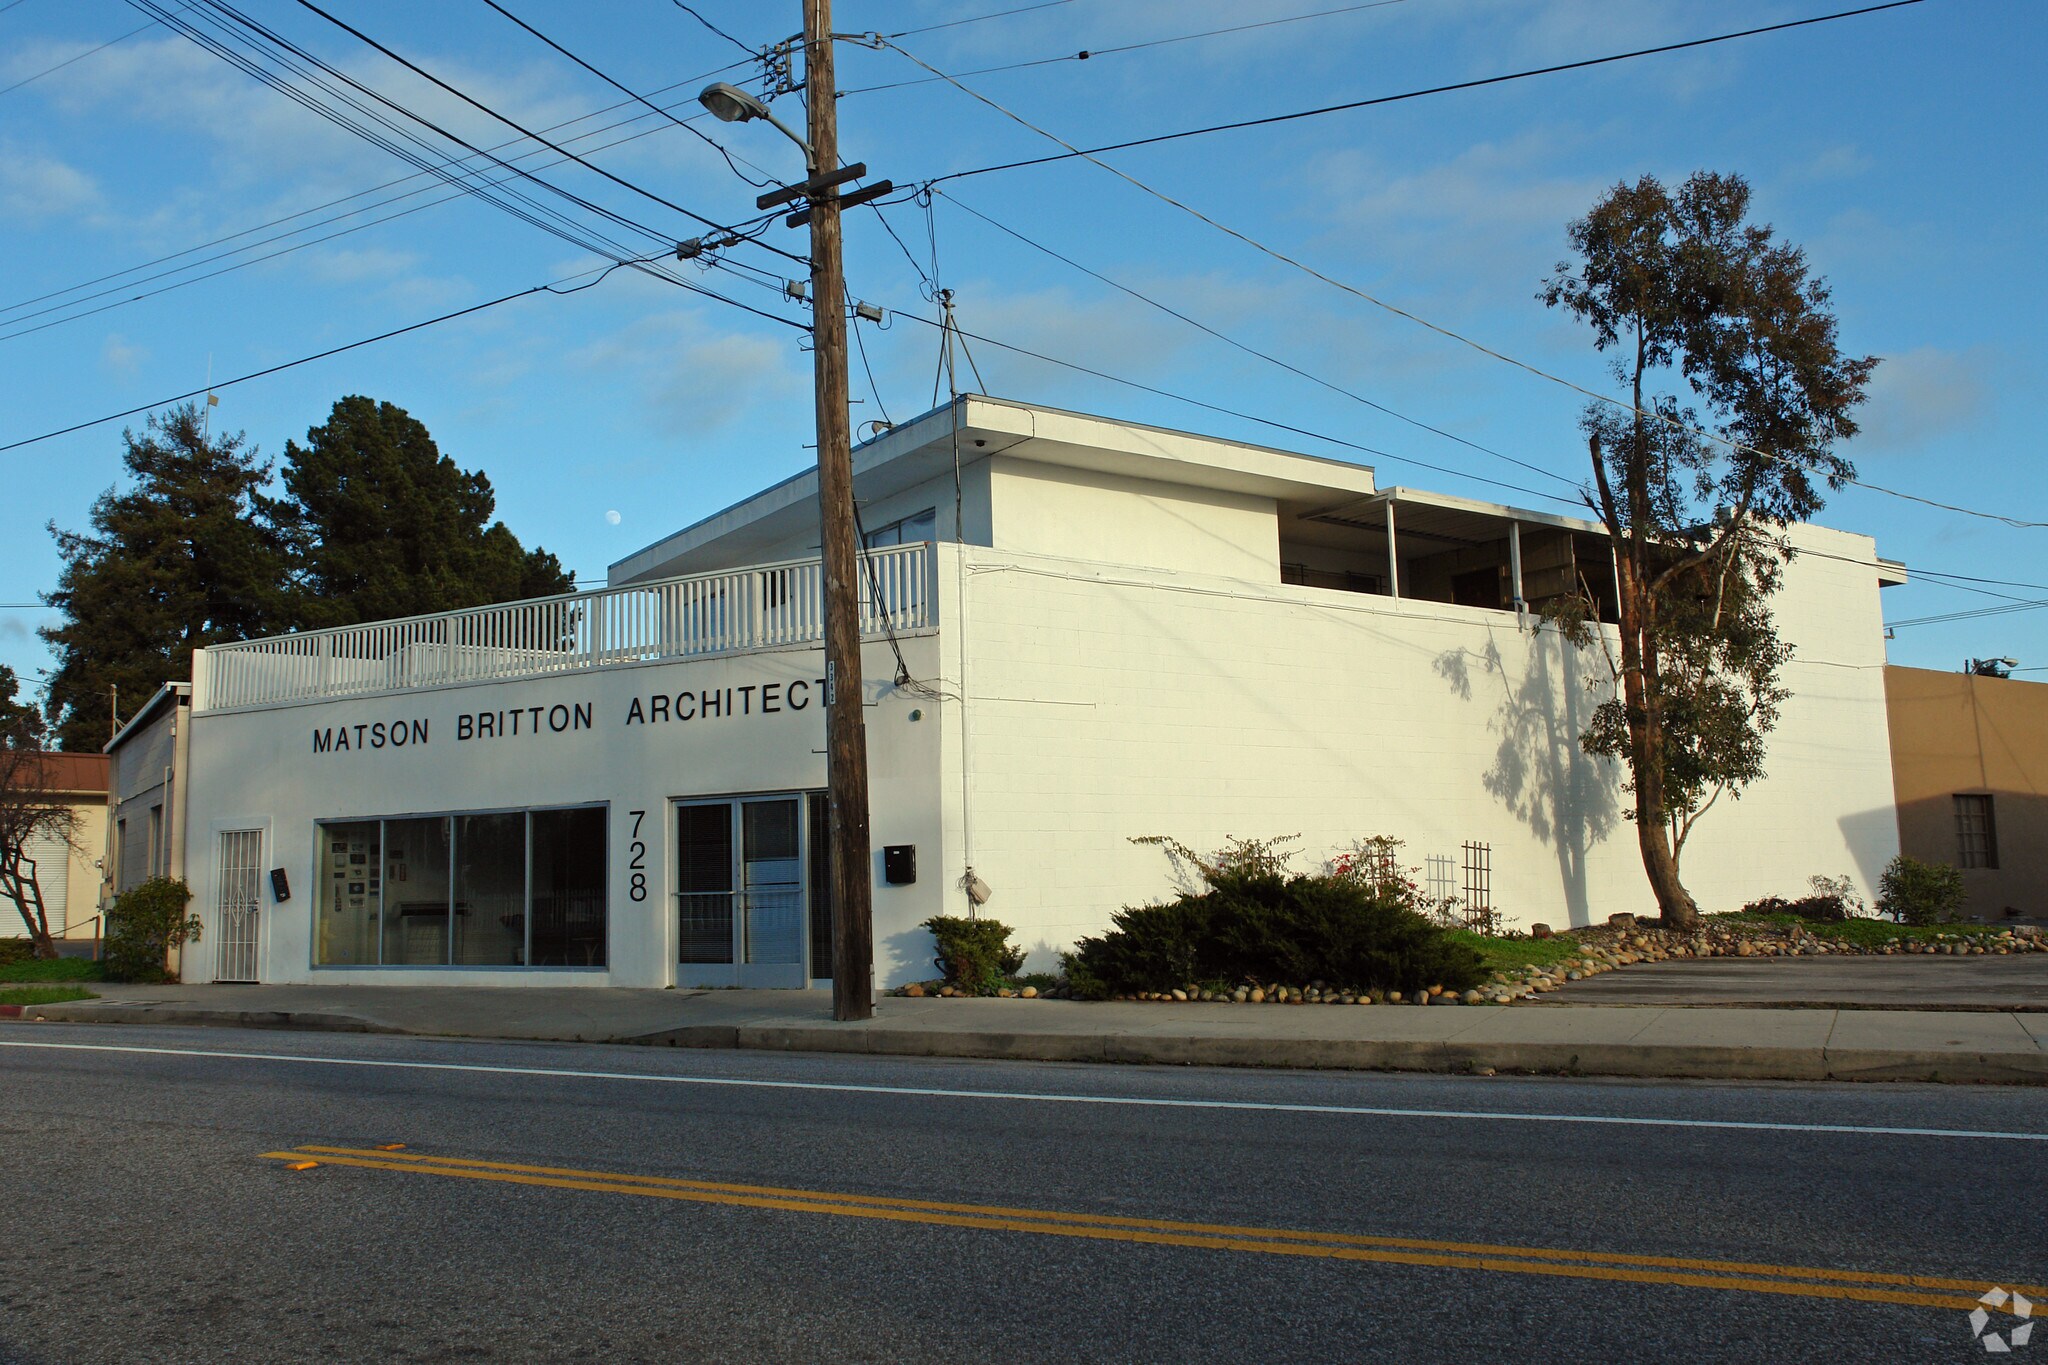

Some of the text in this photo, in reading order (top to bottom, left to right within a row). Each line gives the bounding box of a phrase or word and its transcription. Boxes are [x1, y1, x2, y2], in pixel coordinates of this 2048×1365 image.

[313, 718, 429, 754] MATSON
[457, 702, 592, 741] BRITTON
[629, 810, 647, 903] 728
